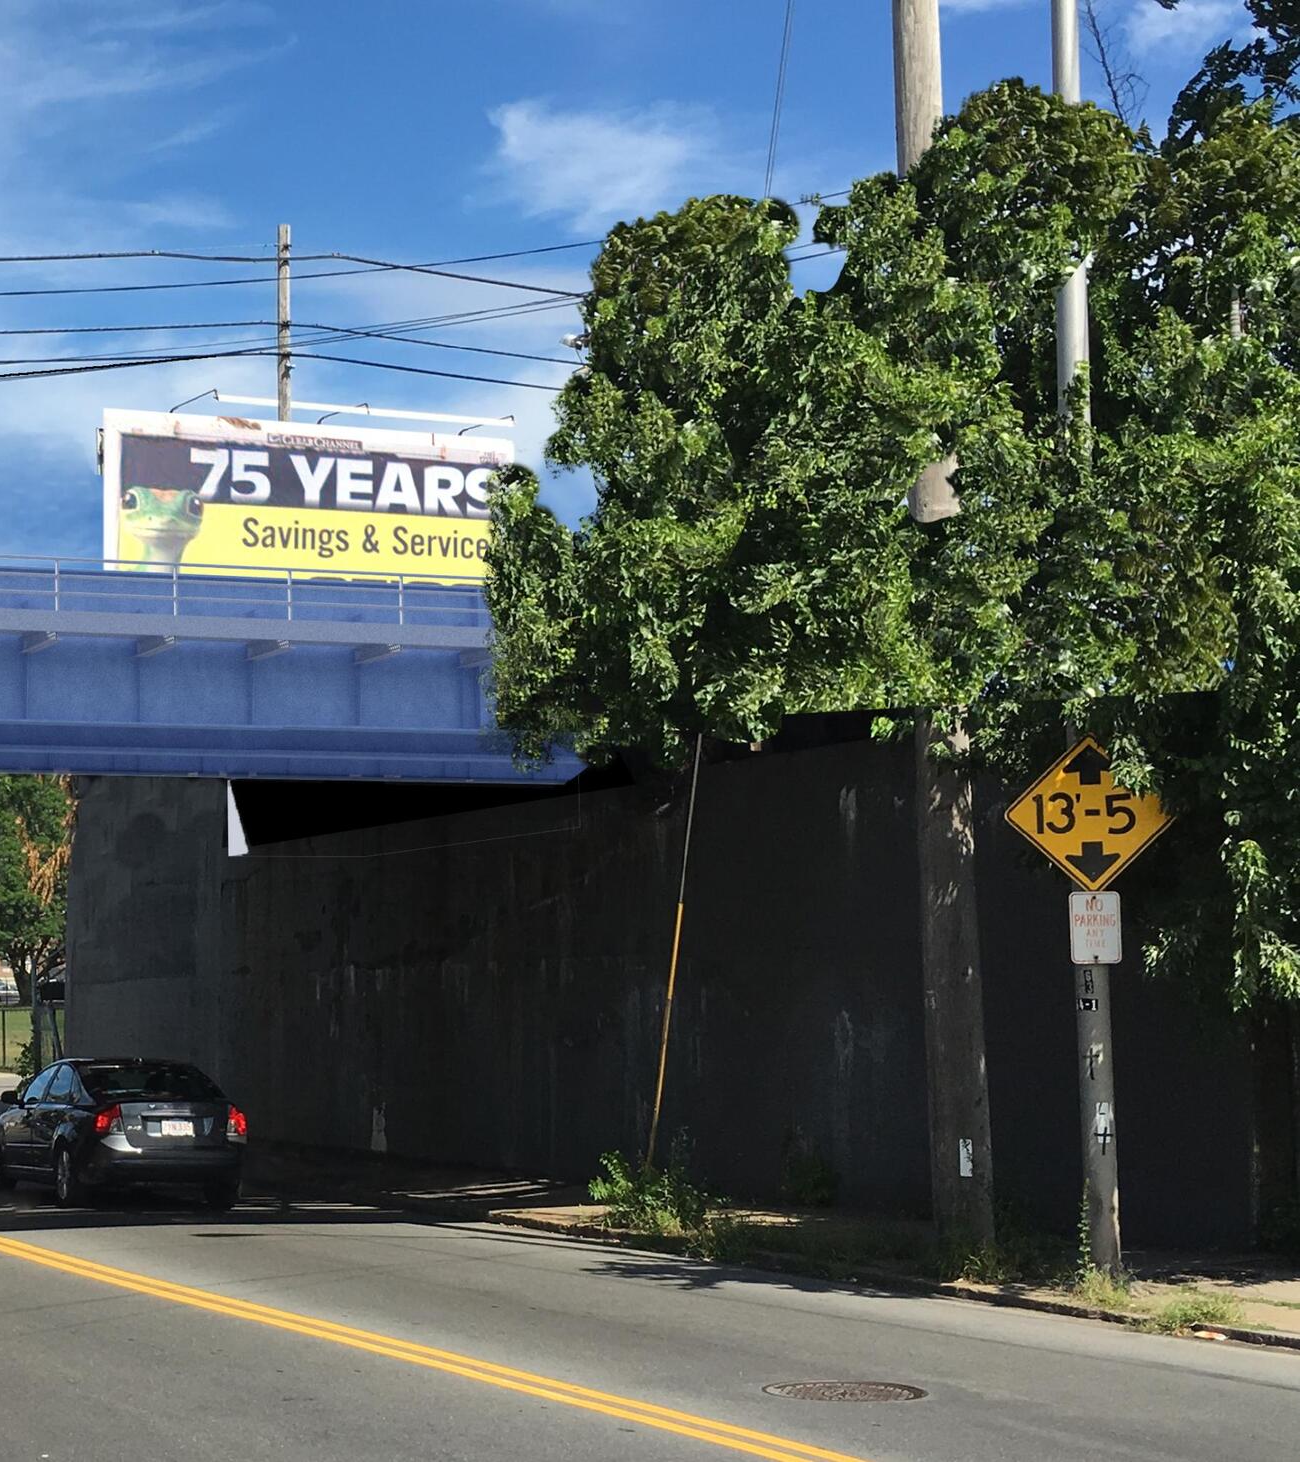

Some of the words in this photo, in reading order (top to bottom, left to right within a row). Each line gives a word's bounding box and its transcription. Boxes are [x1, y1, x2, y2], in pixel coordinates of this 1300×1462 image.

[190, 447, 271, 503] 75
[289, 453, 491, 518] YEARS
[242, 516, 349, 558] Savings
[362, 524, 379, 553] &
[1085, 897, 1103, 912] NO
[1074, 913, 1116, 927] PARKING
[1086, 928, 1104, 938] ANY
